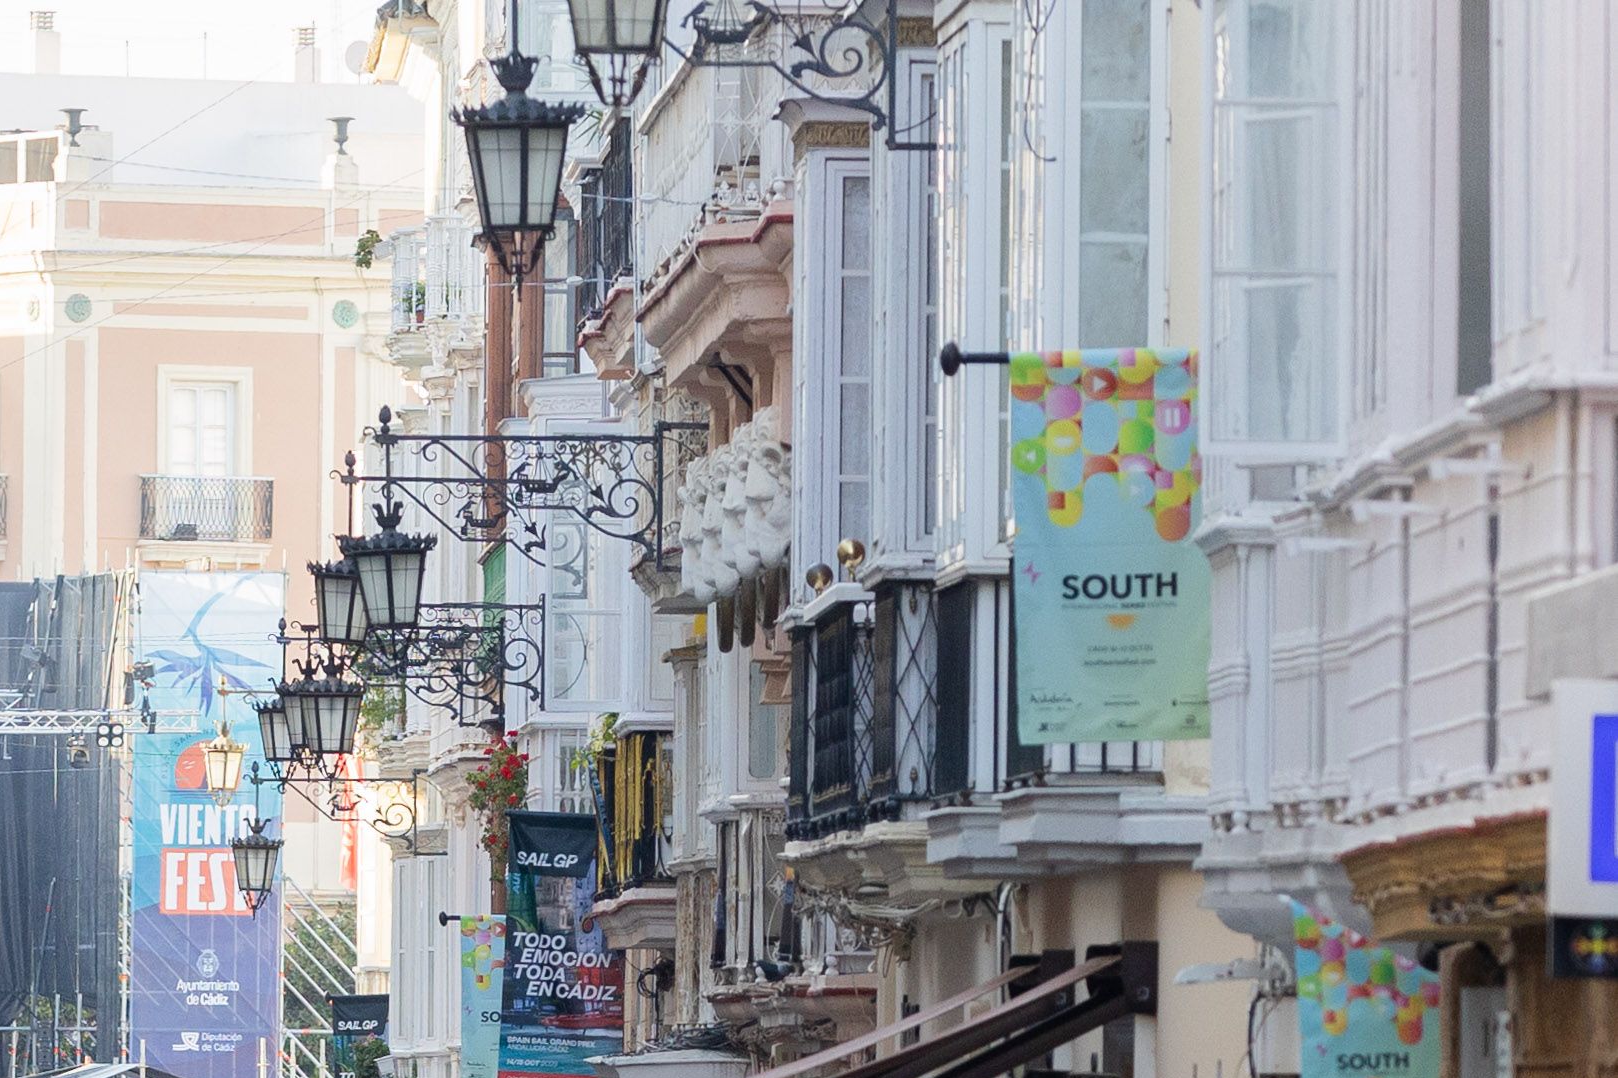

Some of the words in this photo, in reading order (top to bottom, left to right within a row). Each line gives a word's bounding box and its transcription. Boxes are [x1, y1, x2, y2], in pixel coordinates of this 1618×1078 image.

[1061, 571, 1179, 600] SOUTH
[512, 932, 566, 950] TODO
[520, 948, 613, 968] EMOCIÓN
[513, 964, 566, 982] TODA
[176, 978, 240, 993] Ayuntamiento
[526, 981, 554, 997] EN
[555, 980, 618, 1001] CÁDIZ
[186, 993, 199, 1005] de
[200, 993, 229, 1006] Cádiz
[1336, 1051, 1410, 1070] SOUTH
